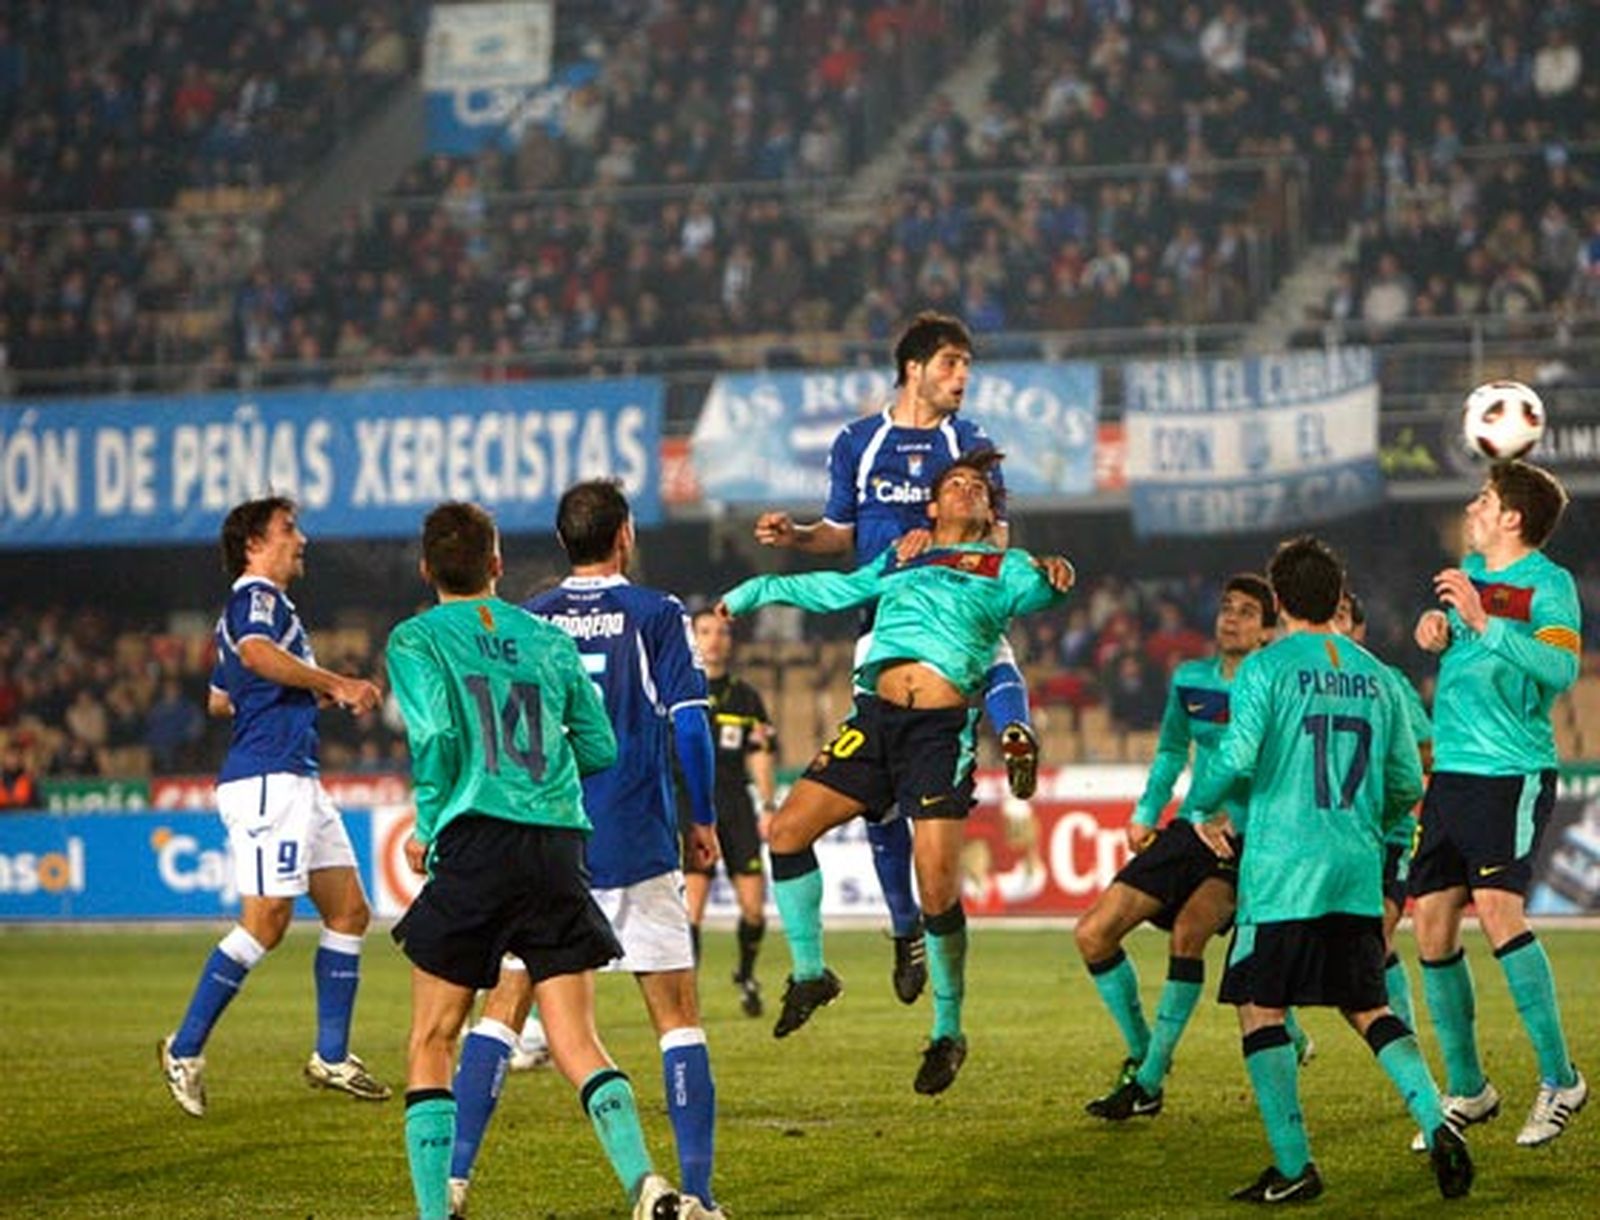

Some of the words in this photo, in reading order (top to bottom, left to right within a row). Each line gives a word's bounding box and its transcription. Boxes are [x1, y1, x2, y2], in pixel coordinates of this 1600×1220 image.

[0, 408, 77, 518] ÓN
[96, 427, 157, 516] DE
[172, 405, 332, 511] PEÑAS
[353, 405, 646, 507] XERECISTAS
[463, 673, 546, 785] 14
[1297, 668, 1382, 699] PLANAS
[1302, 714, 1373, 810] 17
[276, 839, 298, 874] 9
